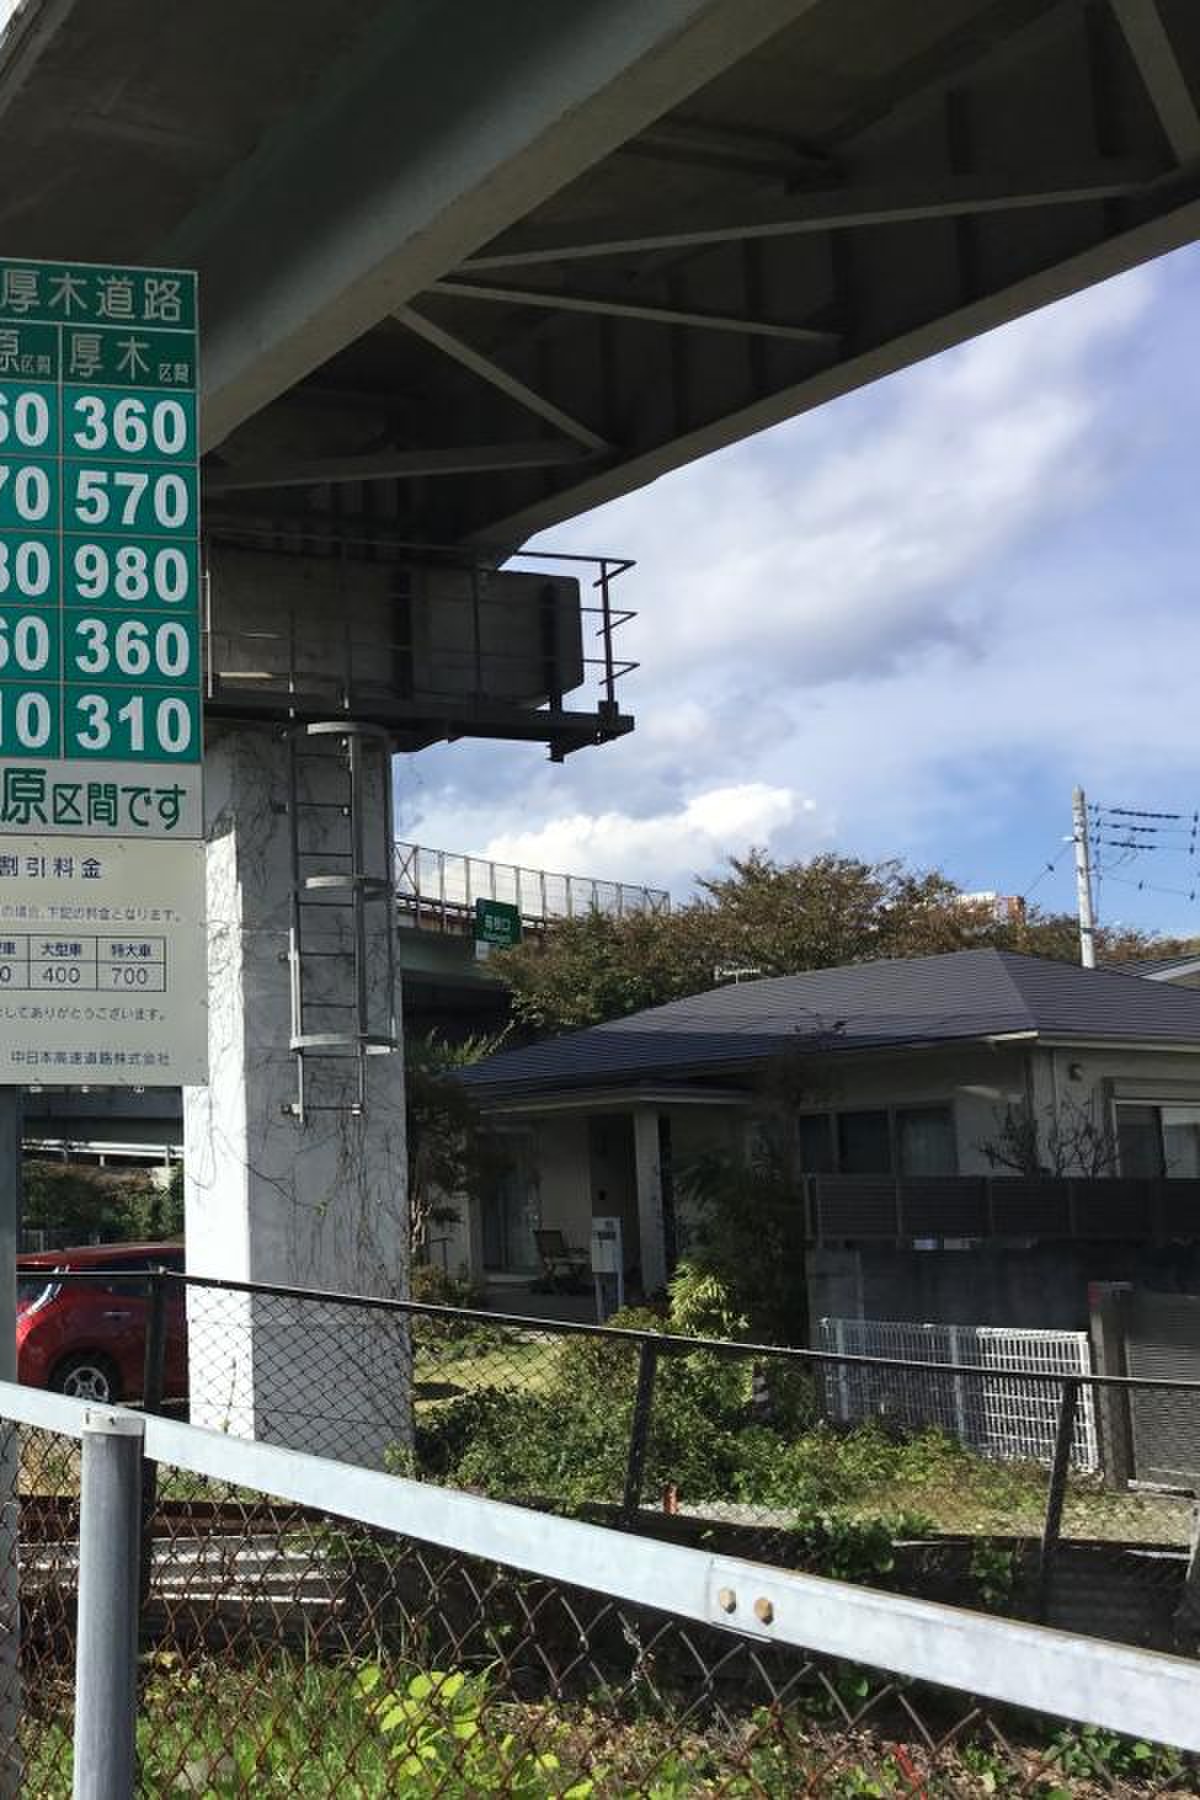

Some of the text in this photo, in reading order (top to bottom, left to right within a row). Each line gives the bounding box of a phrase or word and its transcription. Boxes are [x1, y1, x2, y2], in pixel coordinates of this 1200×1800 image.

[73, 396, 187, 454] 360
[75, 471, 188, 529] 570
[74, 544, 188, 602] 980
[75, 618, 189, 677] 360
[76, 694, 191, 753] 310
[41, 942, 82, 957] 大型車
[111, 943, 152, 959] 特大車
[42, 966, 81, 983] 400
[111, 968, 149, 985] 700
